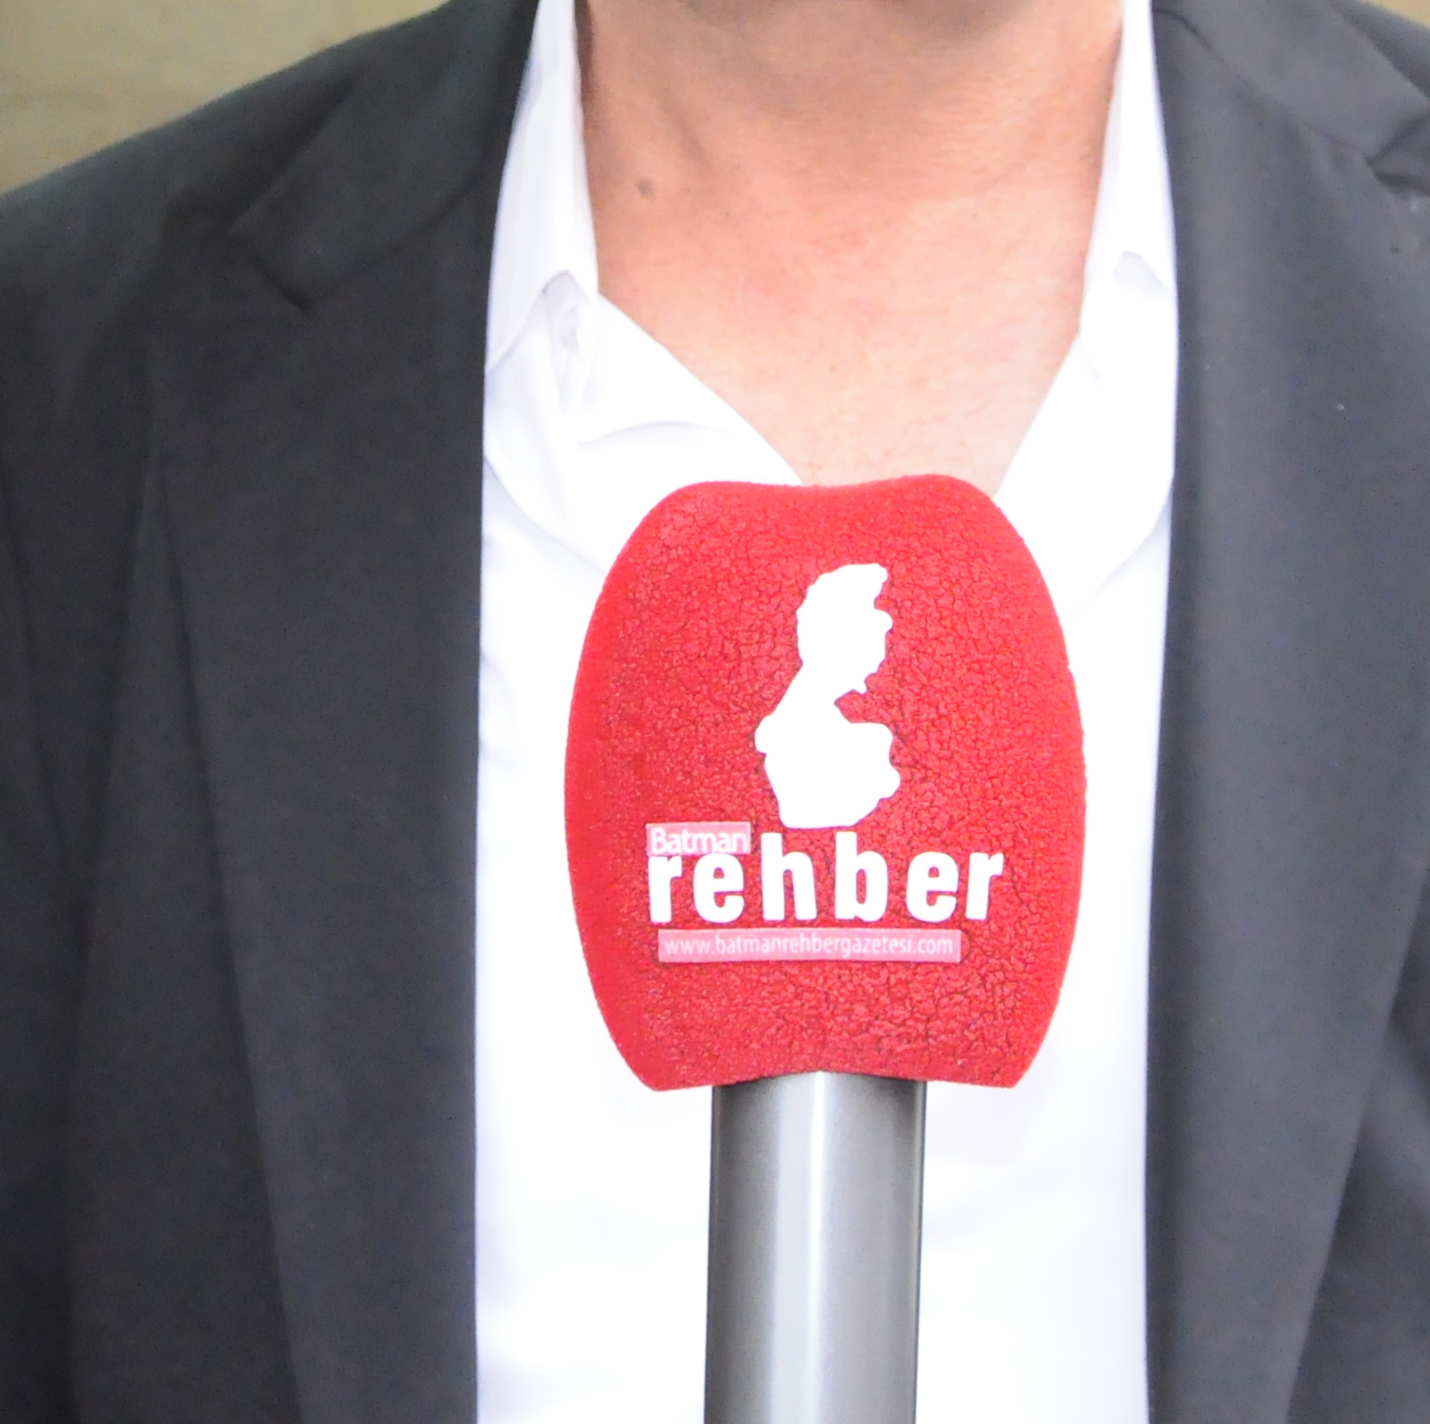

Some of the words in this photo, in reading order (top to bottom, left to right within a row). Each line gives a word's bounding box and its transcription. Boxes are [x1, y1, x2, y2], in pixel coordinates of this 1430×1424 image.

[650, 827, 748, 855] Batman
[647, 831, 1005, 924] rehber
[664, 933, 953, 959] www.batmanrehbergazetesi.com
